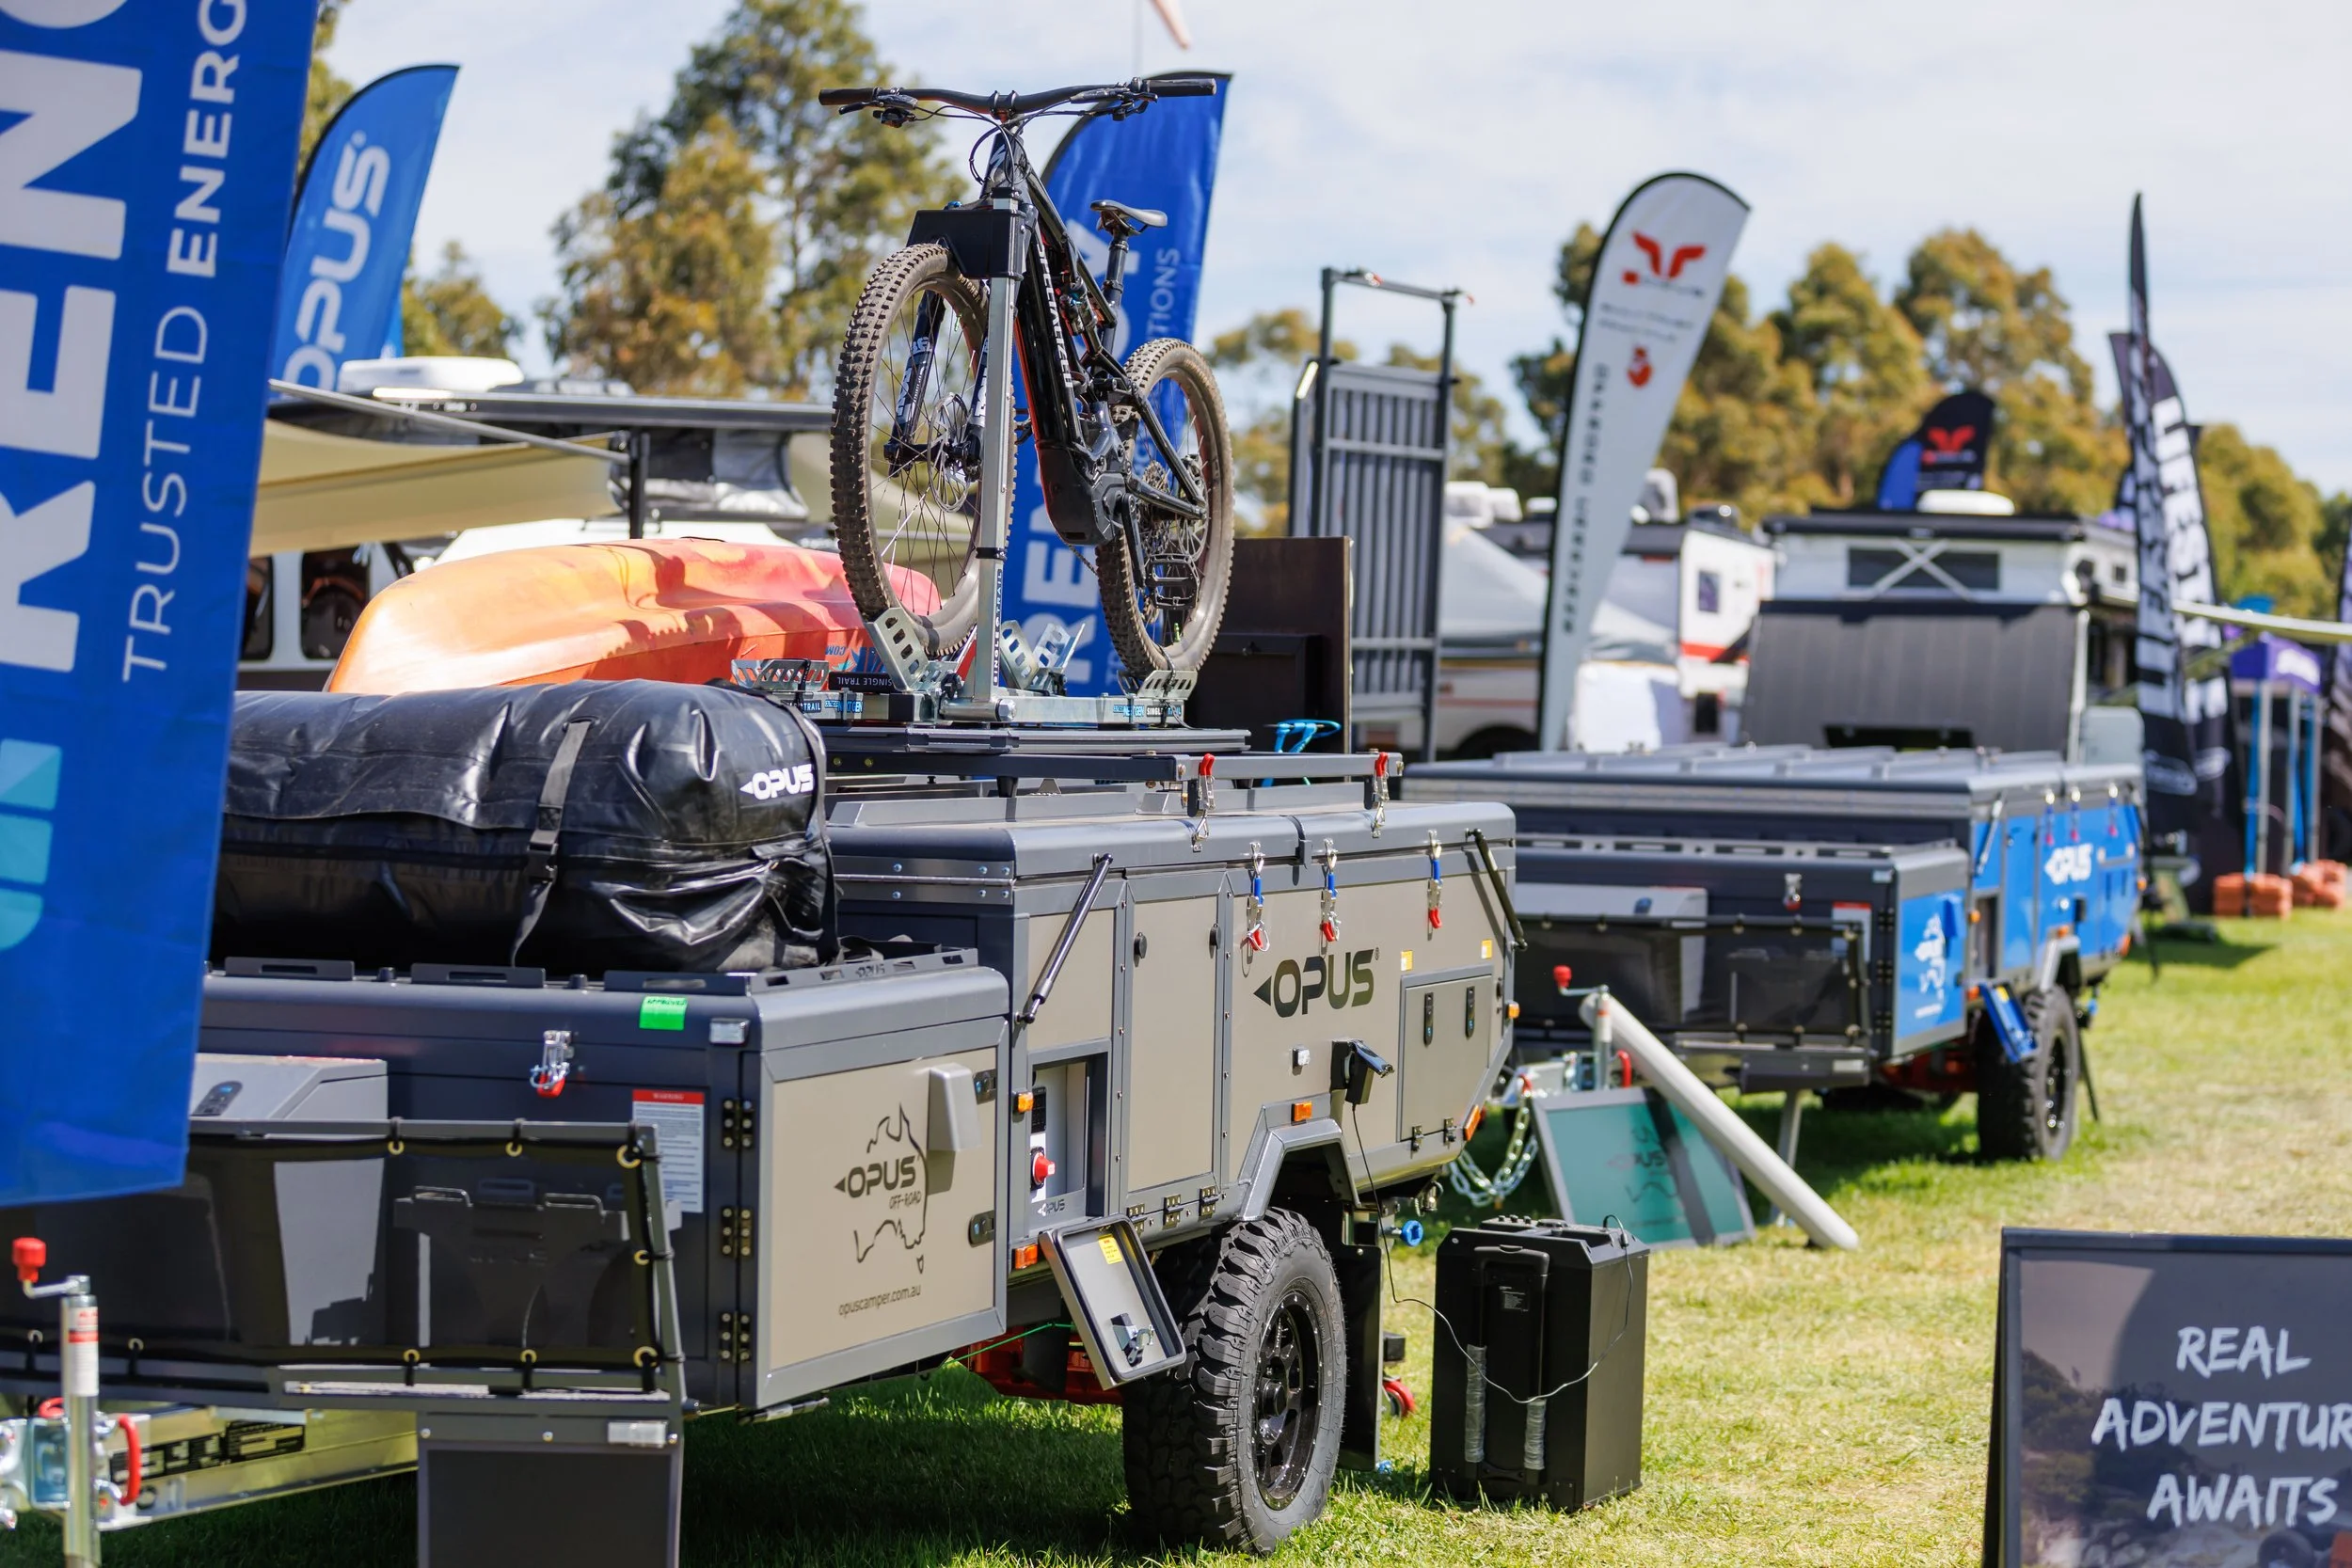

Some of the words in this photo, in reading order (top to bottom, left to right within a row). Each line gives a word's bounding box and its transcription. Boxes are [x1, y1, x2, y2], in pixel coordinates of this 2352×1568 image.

[282, 143, 391, 392] OPUS
[0, 0, 143, 673] REN
[1037, 243, 1073, 388] SPECIALIZED
[122, 306, 208, 683] TRUSTED
[2152, 396, 2227, 723] LIFESTYE
[803, 703, 821, 711] TRAIL
[836, 676, 860, 686] TRAIL
[863, 676, 893, 687] SINGLE
[753, 764, 814, 800] OPUS
[1273, 948, 1375, 1018] OPUS
[848, 1155, 916, 1198] OPUS
[889, 1191, 922, 1210] OFF-ROAD
[838, 1285, 922, 1318] opuscamper.com.au
[2176, 1325, 2312, 1378] REAL
[2091, 1397, 2352, 1452] ADVENTUR
[2146, 1472, 2340, 1528] AWAITS
